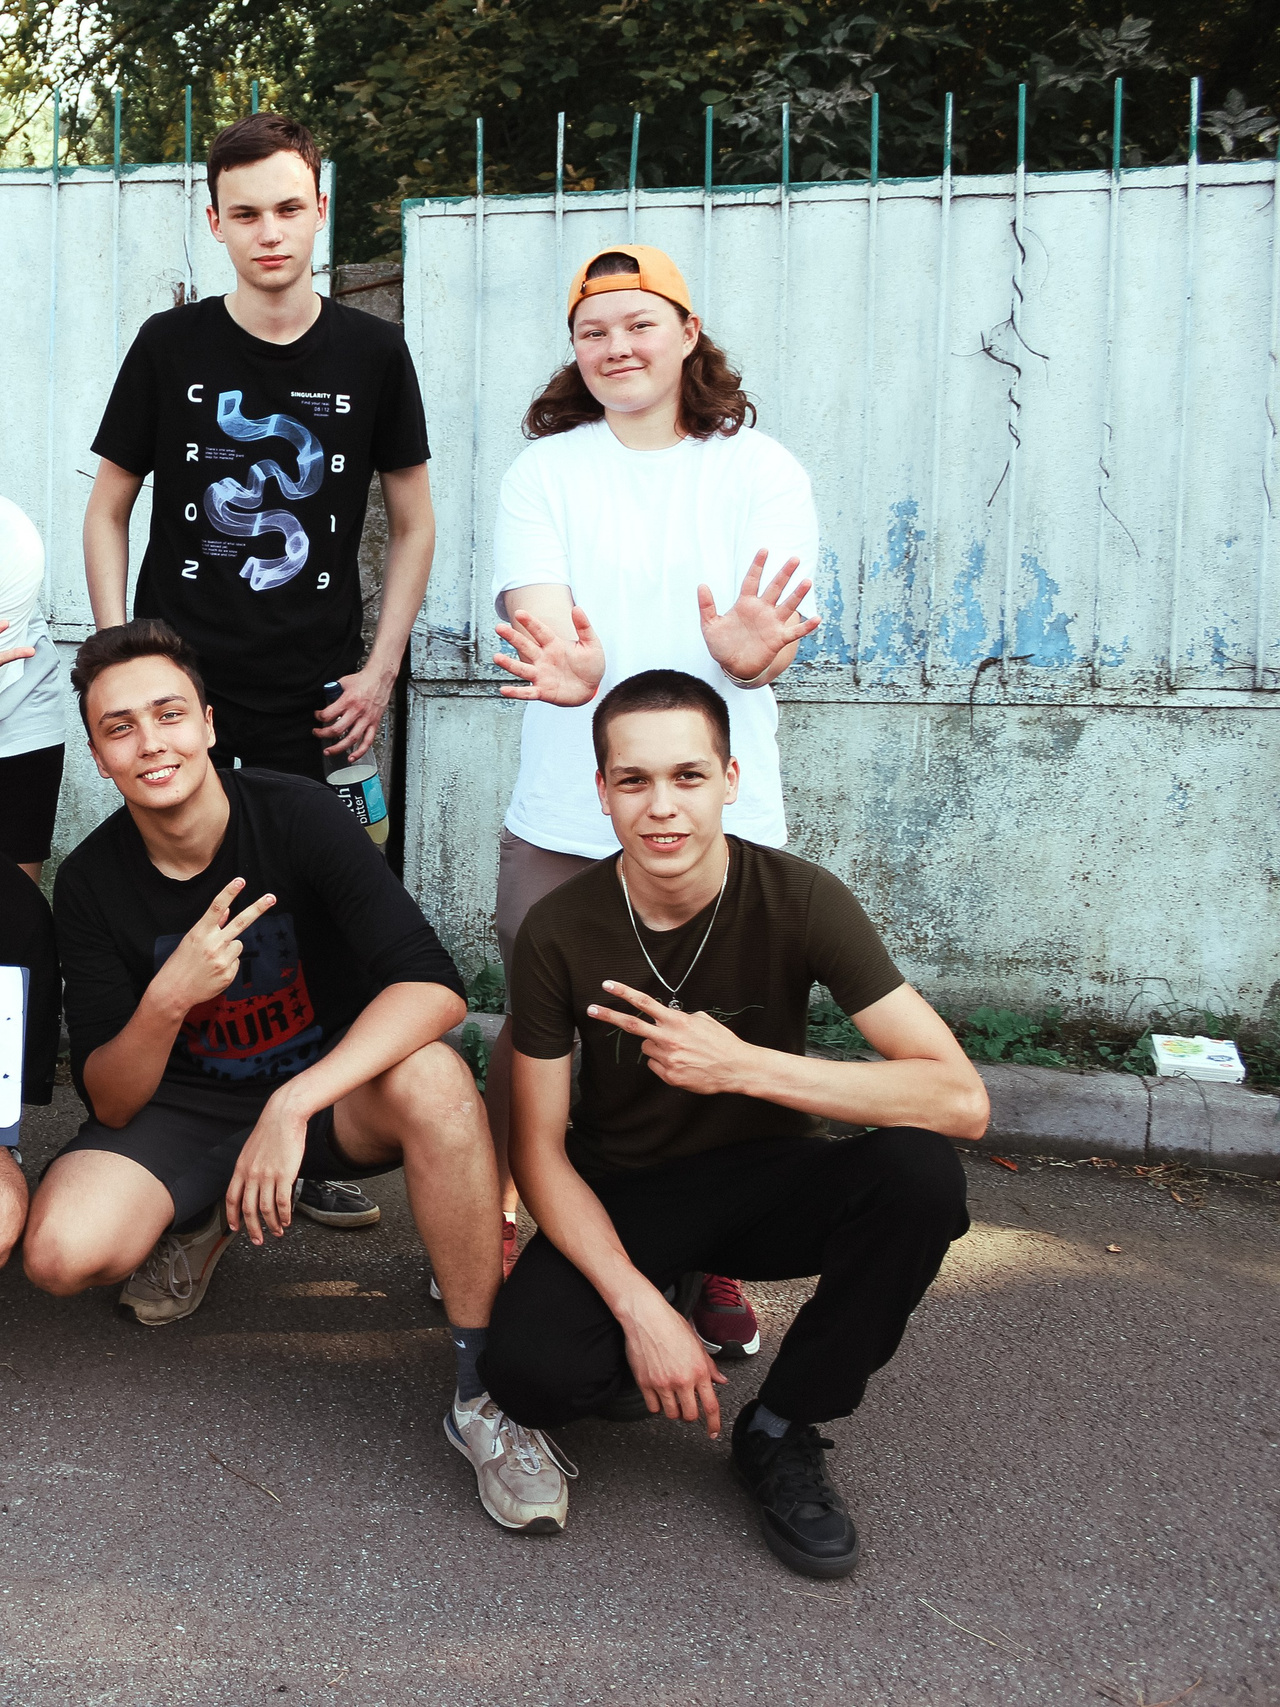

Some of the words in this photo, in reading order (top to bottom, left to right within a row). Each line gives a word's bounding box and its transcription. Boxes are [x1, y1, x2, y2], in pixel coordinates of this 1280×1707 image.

[187, 384, 204, 403] C
[335, 394, 351, 414] 5
[186, 443, 199, 462] R
[330, 454, 345, 473] 8
[316, 572, 330, 590] 9
[337, 787, 354, 812] ch
